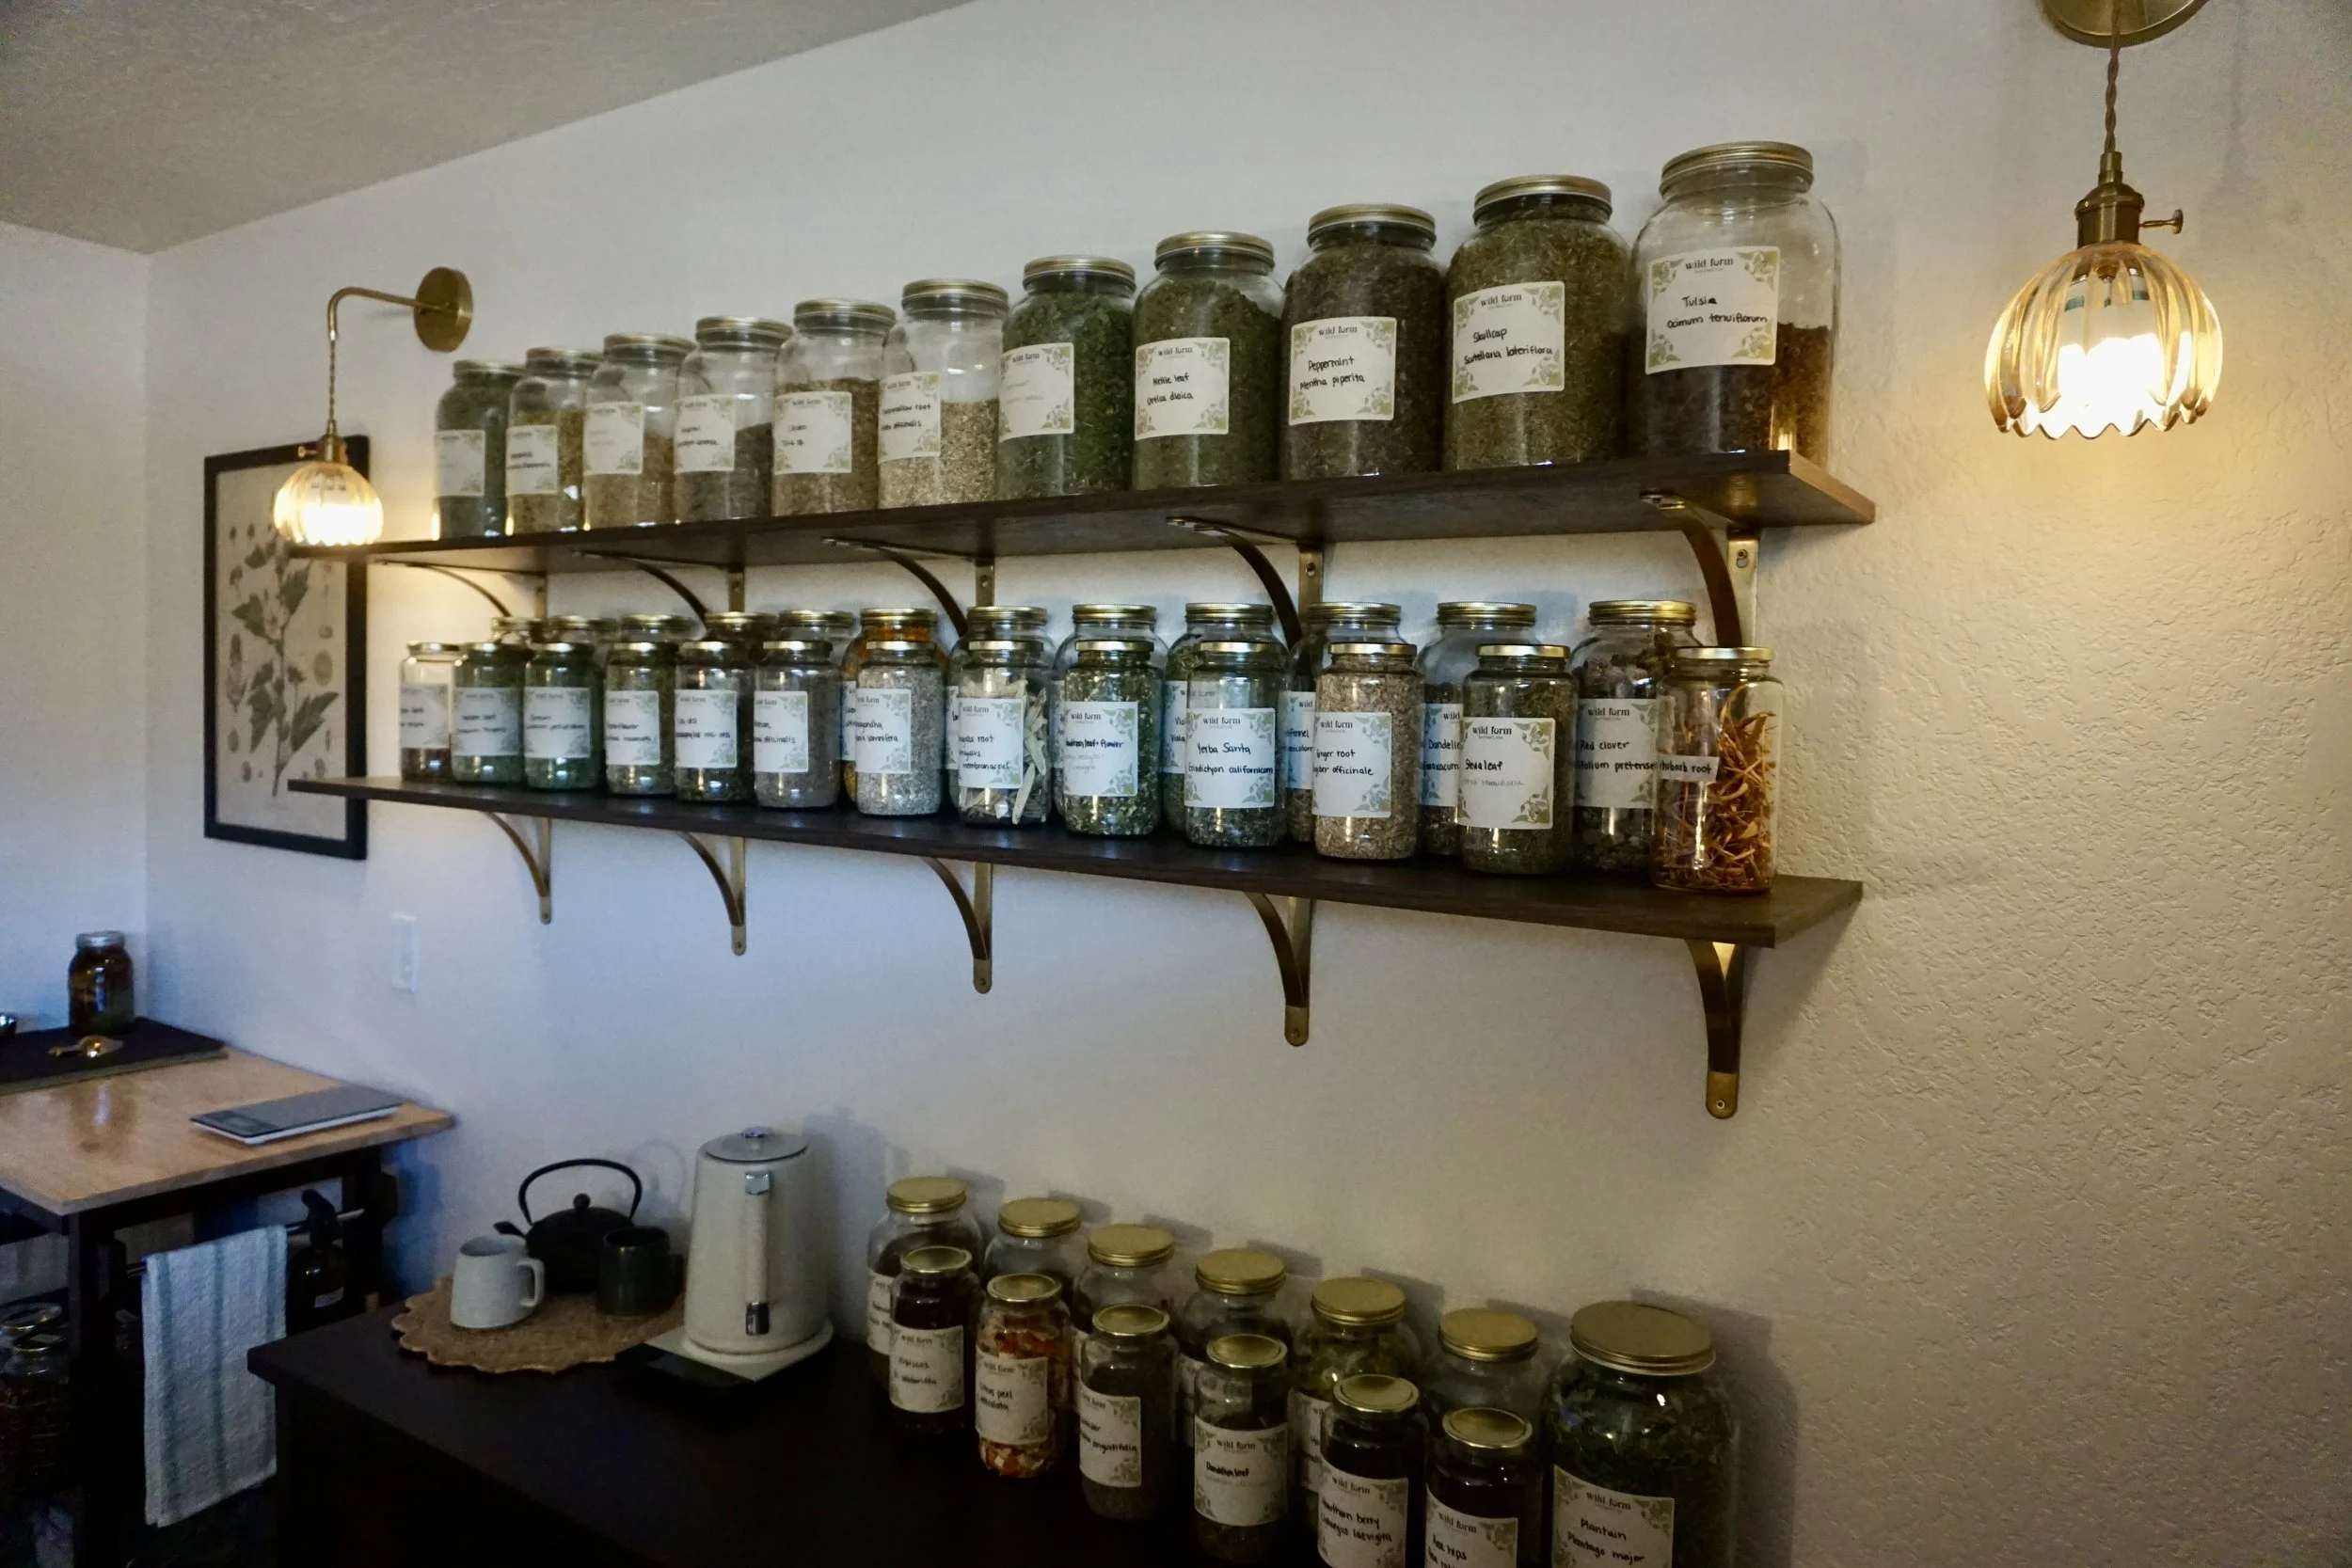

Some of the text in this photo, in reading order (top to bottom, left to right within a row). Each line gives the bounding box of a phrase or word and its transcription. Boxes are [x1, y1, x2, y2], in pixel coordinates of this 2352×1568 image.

[1686, 259, 1707, 271] wild
[1710, 258, 1734, 267] form
[1480, 293, 1522, 307] wild form
[1708, 312, 1768, 324] tenuiflorum
[1318, 325, 1358, 337] wild form
[1472, 328, 1508, 343] Skullcap
[1157, 345, 1194, 357] wild form
[1506, 344, 1553, 357] lateriflora
[1308, 356, 1355, 372] Peppermint
[1173, 372, 1190, 383] leaf
[1299, 372, 1365, 390] Mentha piperita
[1084, 712, 1102, 721] form
[1442, 712, 1461, 721] wild
[1587, 707, 1630, 716] wild form
[1202, 716, 1242, 725] wild form
[1320, 720, 1353, 729] wild form
[1472, 725, 1512, 735] wild form
[1197, 742, 1252, 755] Yerba Santa
[1599, 740, 1630, 751] clover
[1336, 749, 1357, 758] root
[1229, 765, 1273, 775] californicum
[1484, 759, 1503, 771] leaf
[1691, 763, 1712, 775] root
[1332, 766, 1374, 777] officinale
[1216, 1439, 1234, 1449] wild
[1331, 1475, 1371, 1495] wild form
[1586, 1491, 1632, 1511] wild form
[1455, 1519, 1478, 1534] form
[1580, 1517, 1628, 1541] Plantain
[1566, 1529, 1646, 1566] Plantago major
